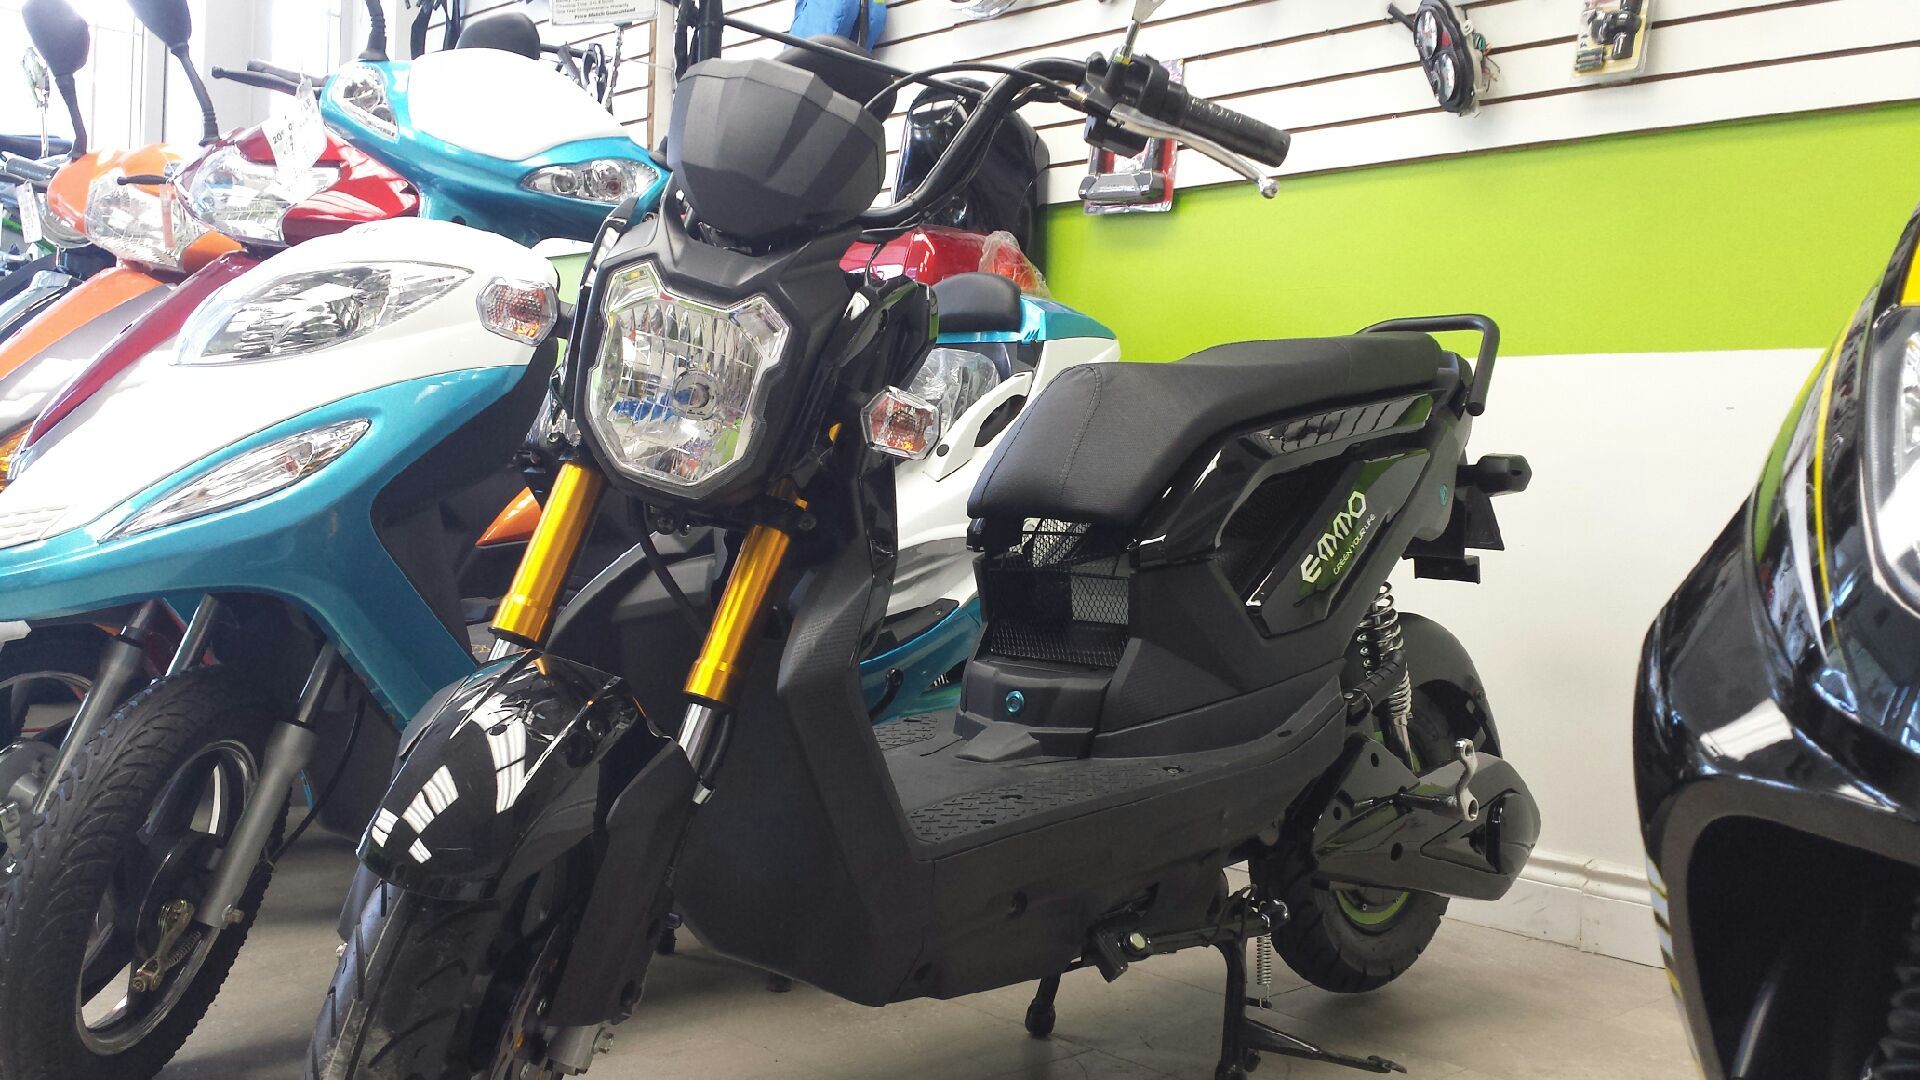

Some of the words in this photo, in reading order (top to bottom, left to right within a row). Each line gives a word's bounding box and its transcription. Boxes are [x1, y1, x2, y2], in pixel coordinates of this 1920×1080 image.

[605, 7, 636, 16] Guaranteed
[1301, 490, 1367, 583] EMMO
[1333, 547, 1352, 575] GREEN
[1351, 527, 1367, 549] YOUR
[1364, 513, 1377, 530] LIFE
